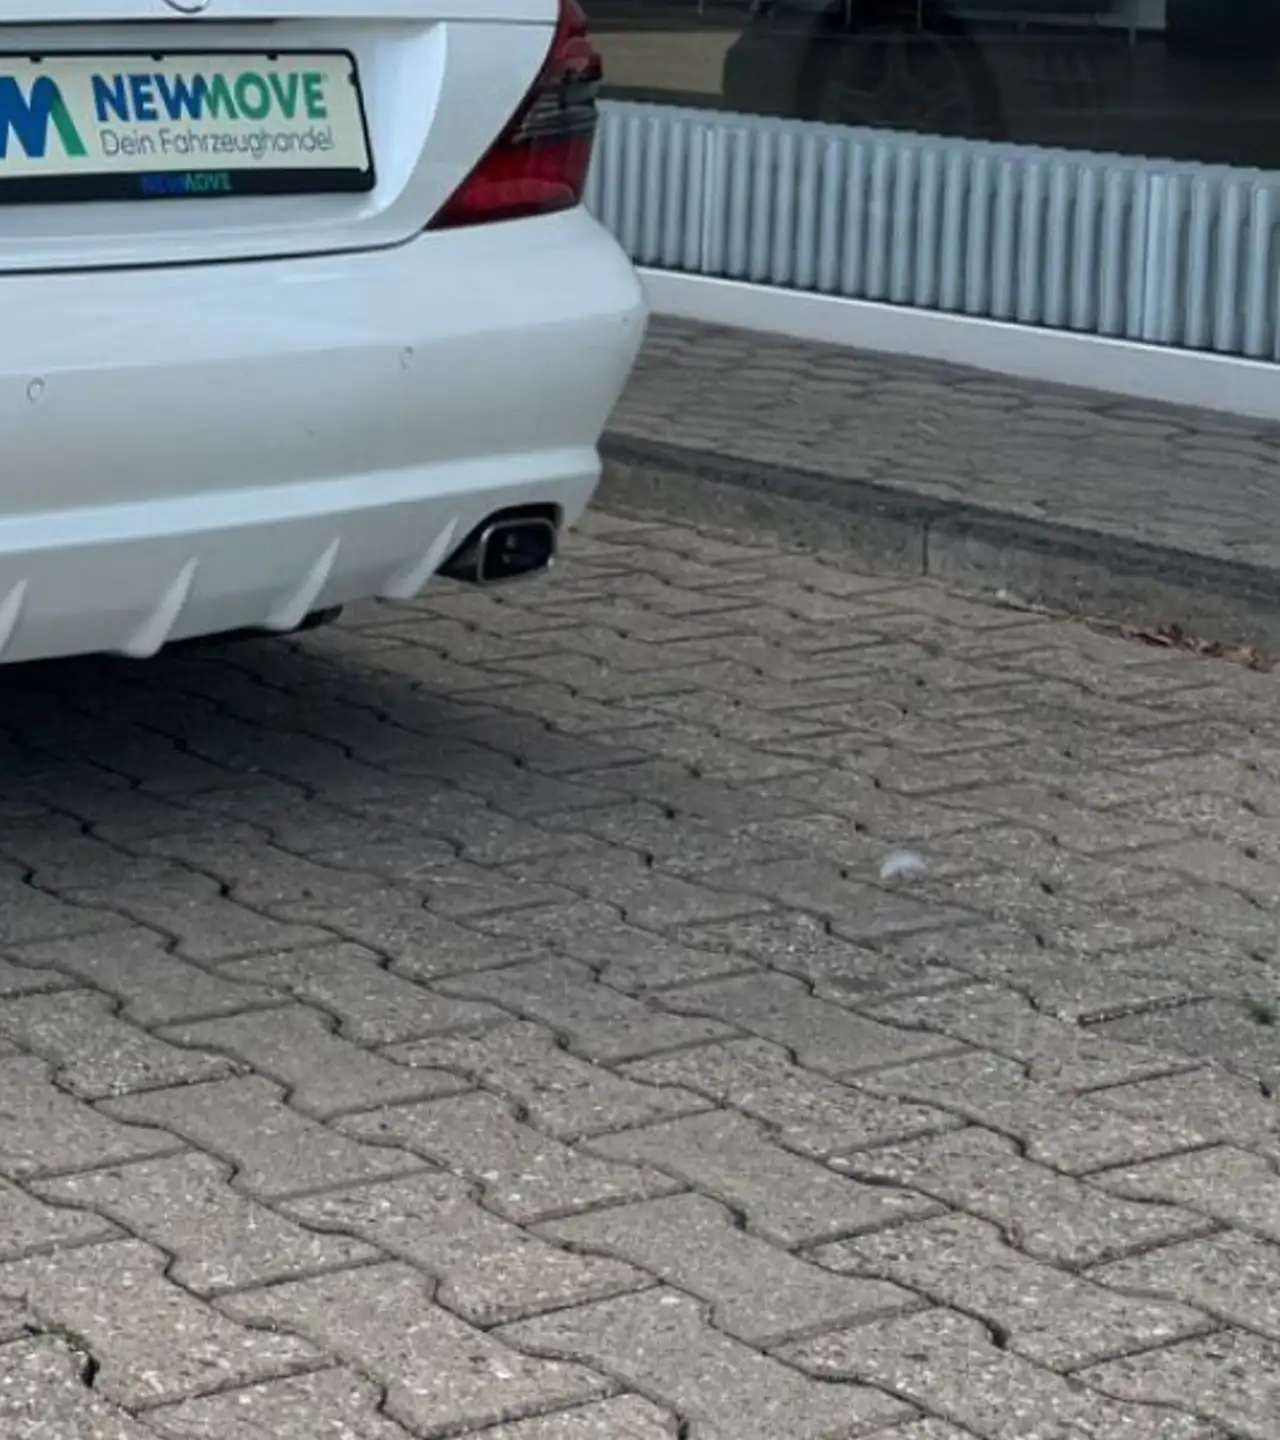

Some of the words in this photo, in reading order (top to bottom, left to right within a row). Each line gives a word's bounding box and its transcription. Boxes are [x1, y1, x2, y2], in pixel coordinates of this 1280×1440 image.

[91, 71, 328, 123] NEWMOVE
[100, 128, 156, 157] Dein
[159, 125, 335, 159] Fahrzeughandel
